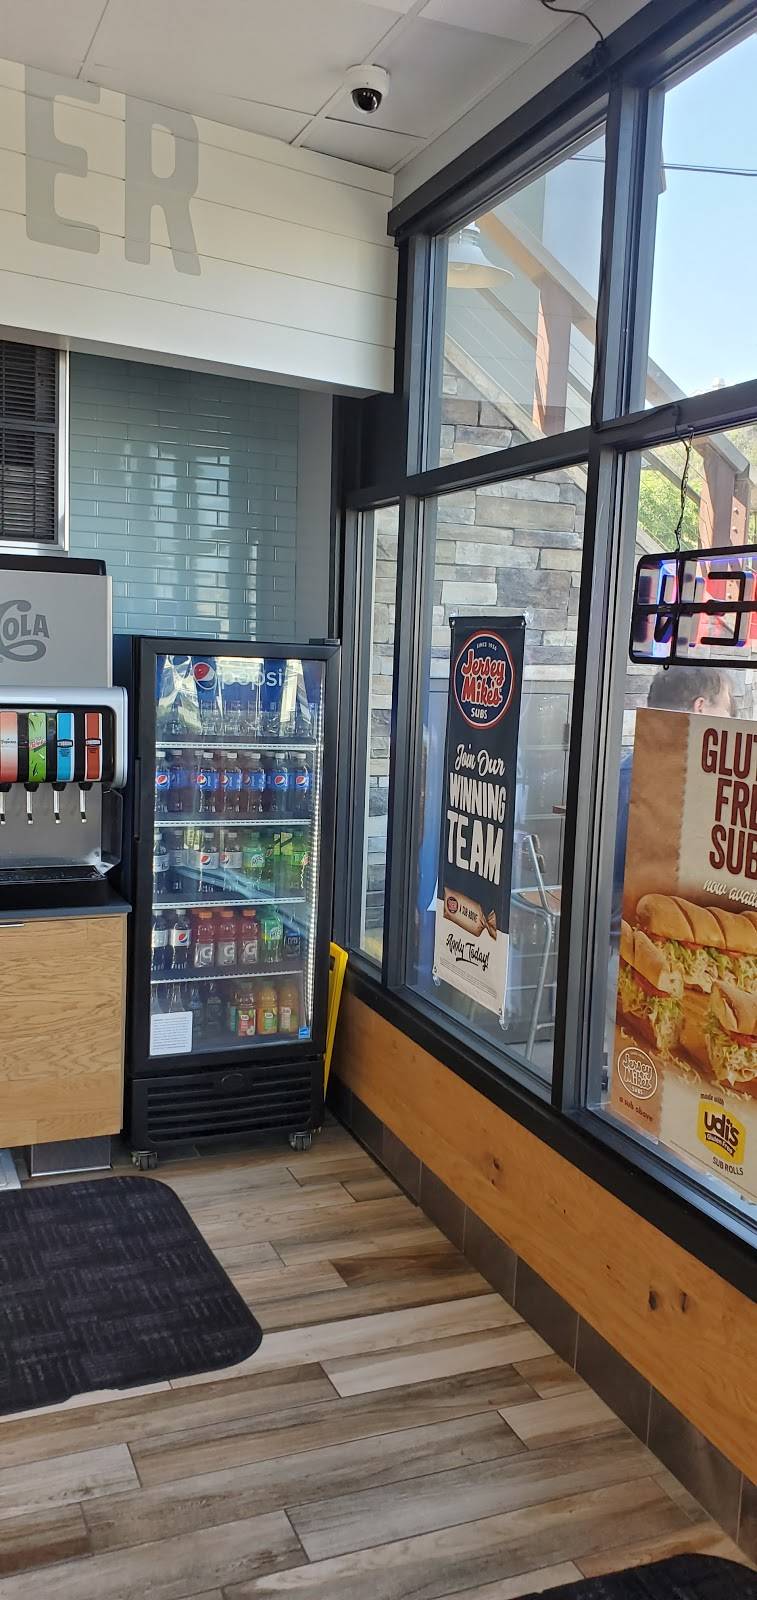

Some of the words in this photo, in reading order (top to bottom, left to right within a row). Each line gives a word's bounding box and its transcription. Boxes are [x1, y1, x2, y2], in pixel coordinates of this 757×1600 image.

[461, 649, 506, 688] Jersey
[470, 707, 488, 720] SUBS
[455, 743, 476, 771] Join
[477, 749, 505, 776] Our
[701, 727, 757, 780] GLU
[449, 772, 507, 824] WINNING
[447, 809, 504, 886] TEAM
[703, 880, 727, 895] now
[446, 933, 464, 959] Apply
[465, 942, 490, 971] Today!
[622, 1053, 653, 1081] Jersey
[624, 1100, 634, 1110] sub
[635, 1106, 653, 1122] above
[700, 1093, 713, 1101] made
[713, 1096, 724, 1106] with
[712, 1156, 724, 1169] SUB
[724, 1164, 744, 1176] ROLLS
